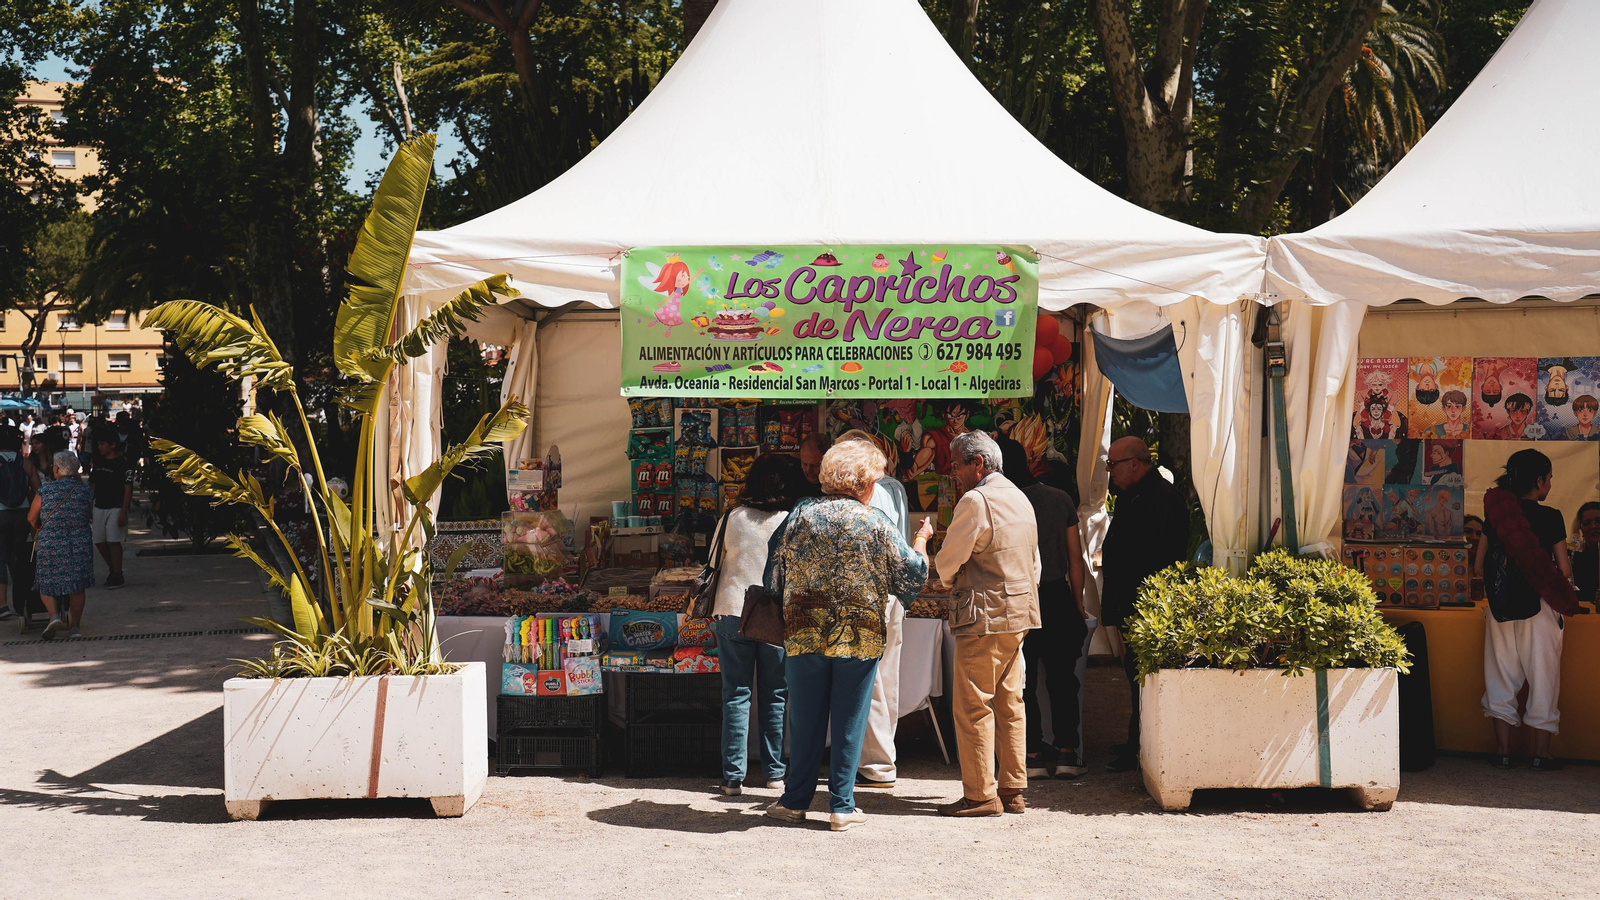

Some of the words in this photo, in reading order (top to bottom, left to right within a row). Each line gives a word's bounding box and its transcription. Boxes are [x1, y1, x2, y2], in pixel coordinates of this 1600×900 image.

[724, 271, 782, 299] Los
[784, 251, 1020, 312] Caprichos
[793, 311, 839, 339] de
[843, 308, 1001, 342] Nerea
[639, 343, 721, 361] ALIMENTACIÓN
[723, 346, 731, 361] Y
[733, 343, 792, 361] ARTÍCULOS
[795, 346, 824, 361] PARA
[826, 346, 913, 361] CELEBRACIONES
[936, 343, 963, 360] 627
[966, 343, 992, 360] 984
[996, 343, 1022, 360] 495
[639, 375, 672, 390] Avda.
[674, 375, 720, 390] Oceanía
[729, 375, 793, 390] Residencial
[796, 376, 817, 390] San
[819, 376, 860, 390] Marcos
[869, 375, 903, 390] Portal
[906, 376, 911, 390] 1
[922, 375, 951, 390] Local
[954, 376, 959, 390] 1
[970, 375, 1021, 394] Algeciras
[622, 623, 661, 634] POTENZA
[627, 635, 655, 646] GAME
[568, 669, 599, 683] Bubble
